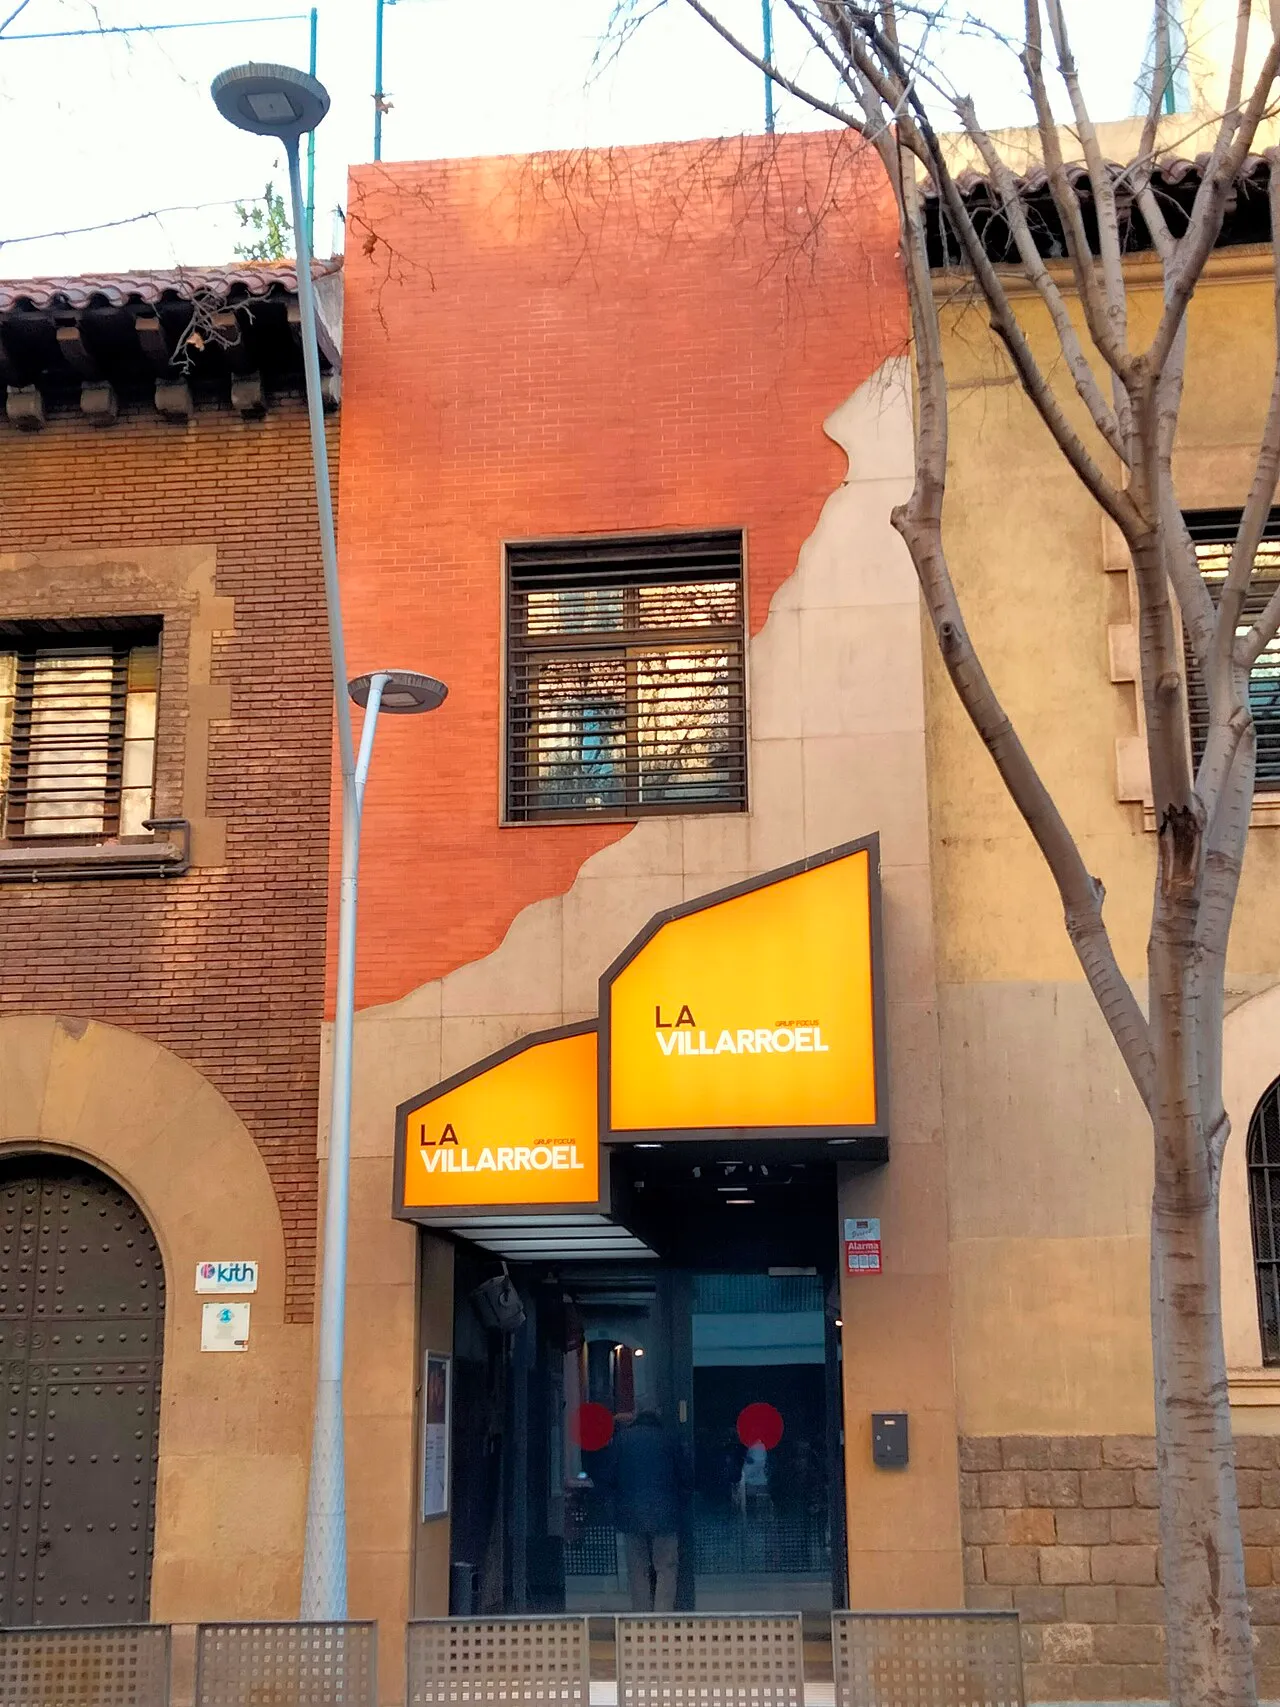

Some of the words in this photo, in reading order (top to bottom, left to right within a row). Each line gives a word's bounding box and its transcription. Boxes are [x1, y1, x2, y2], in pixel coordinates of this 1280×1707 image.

[655, 1005, 696, 1028] LA
[796, 1019, 820, 1027] FOCUS
[655, 1027, 829, 1056] VILLARROEL
[420, 1123, 459, 1146] LA
[420, 1145, 584, 1173] VILLARROEL
[848, 1242, 879, 1250] Alarma
[217, 1263, 254, 1282] kith
